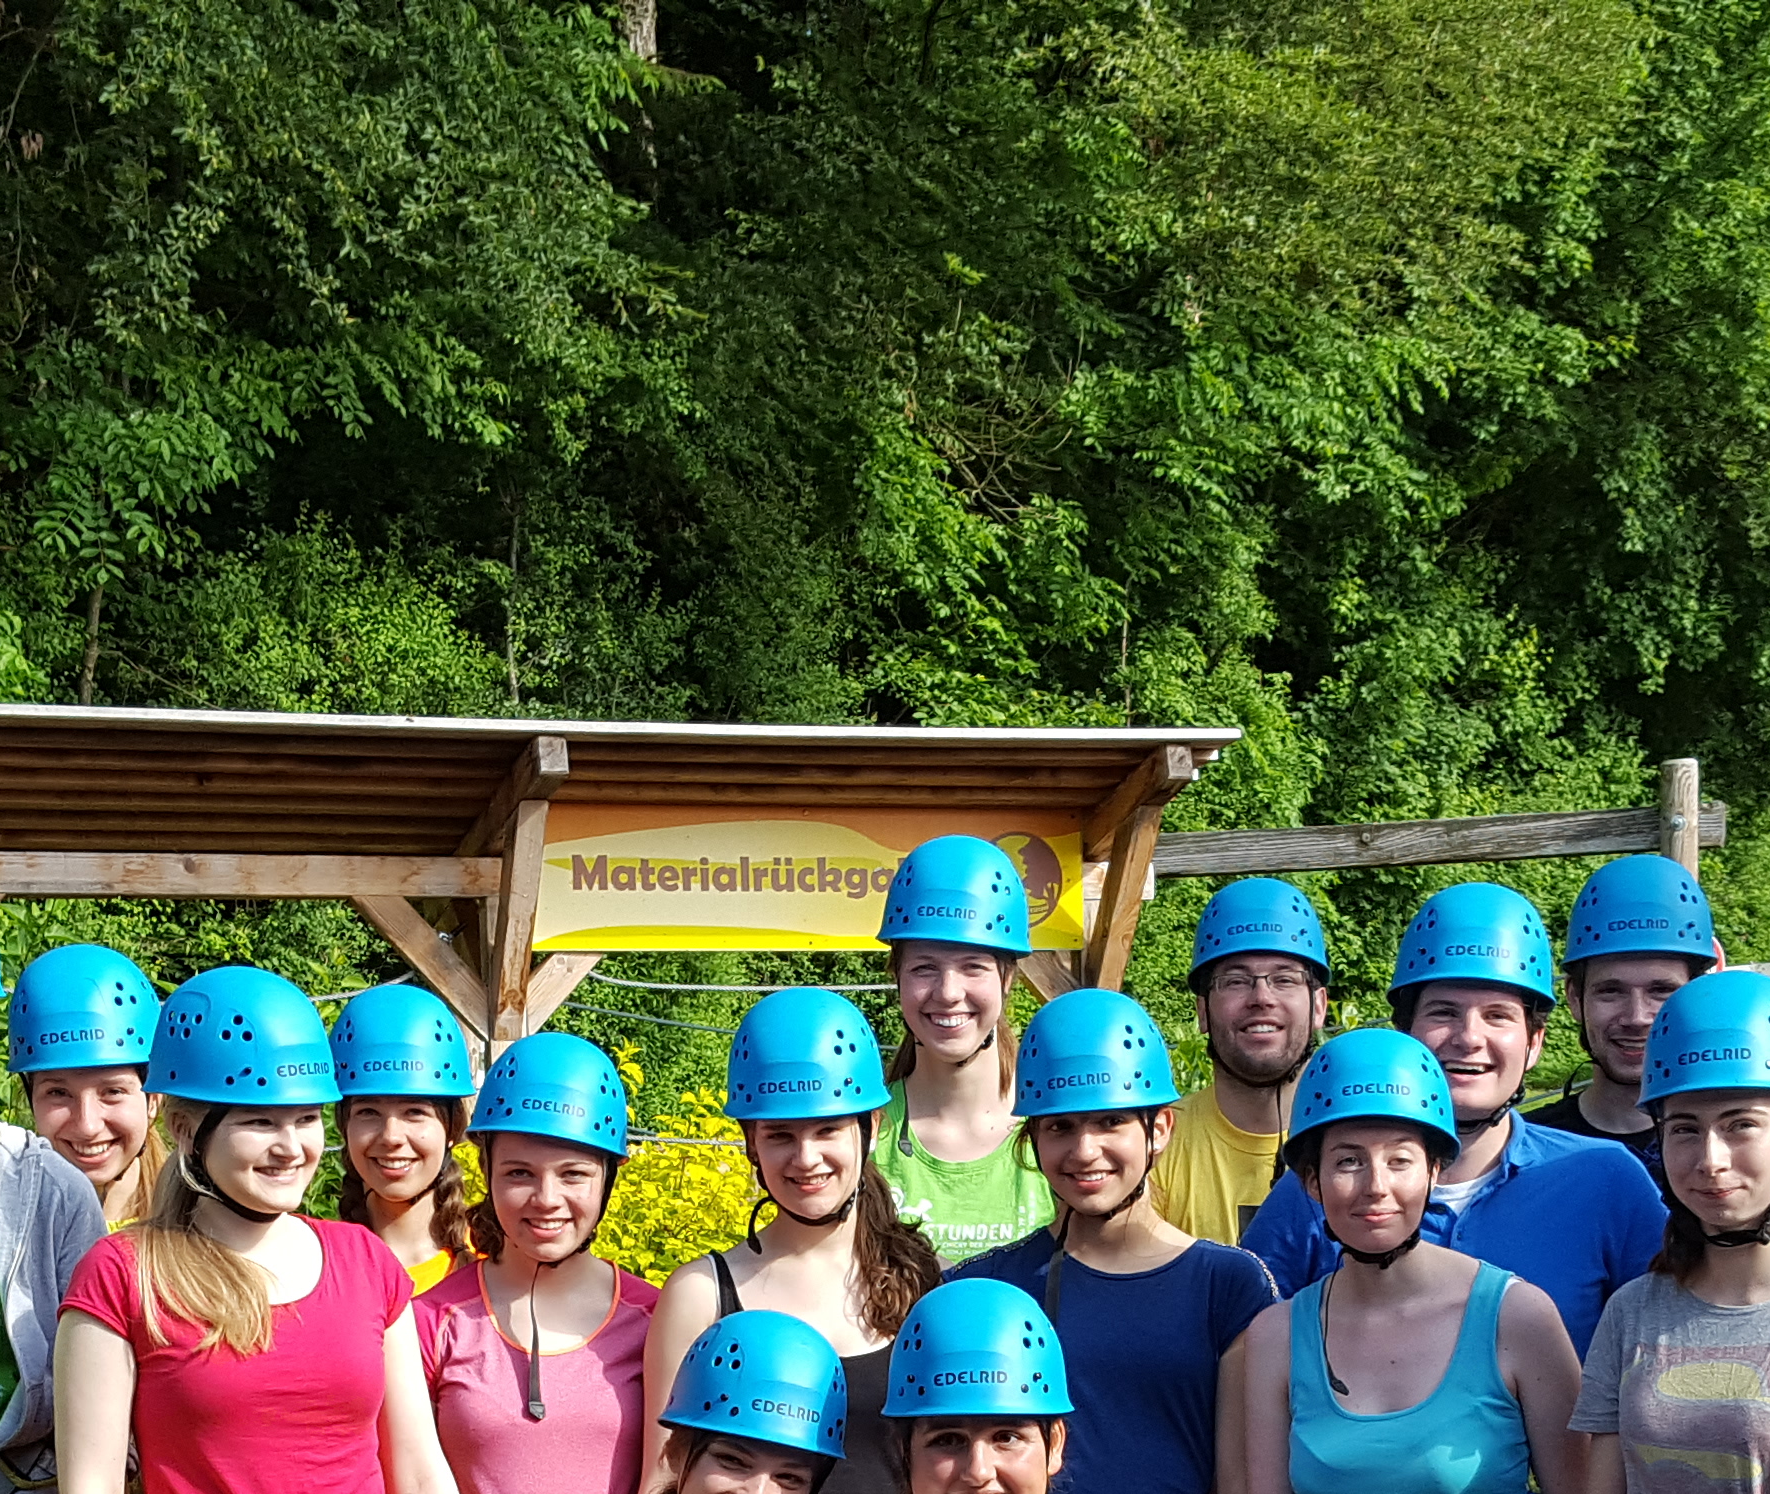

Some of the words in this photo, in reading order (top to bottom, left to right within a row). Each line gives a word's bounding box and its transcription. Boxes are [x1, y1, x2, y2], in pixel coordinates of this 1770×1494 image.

[571, 854, 906, 899] Materialrückga
[917, 906, 976, 920] EDELRID
[1227, 923, 1283, 935] EDELRID
[1608, 919, 1669, 931] EDELRID
[1445, 945, 1511, 959] EDELRID
[40, 1029, 104, 1045] EDELRID
[1678, 1048, 1751, 1065] EDELRID
[277, 1062, 331, 1076] EDELRID
[363, 1060, 423, 1072] EDELRID
[759, 1080, 822, 1094] EDELRID
[1047, 1073, 1111, 1089] EDELRID
[1342, 1083, 1410, 1096] EDELRID
[522, 1099, 585, 1117] EDELRID
[934, 1371, 1007, 1386] EDELRID
[752, 1399, 820, 1423] EDELRID
